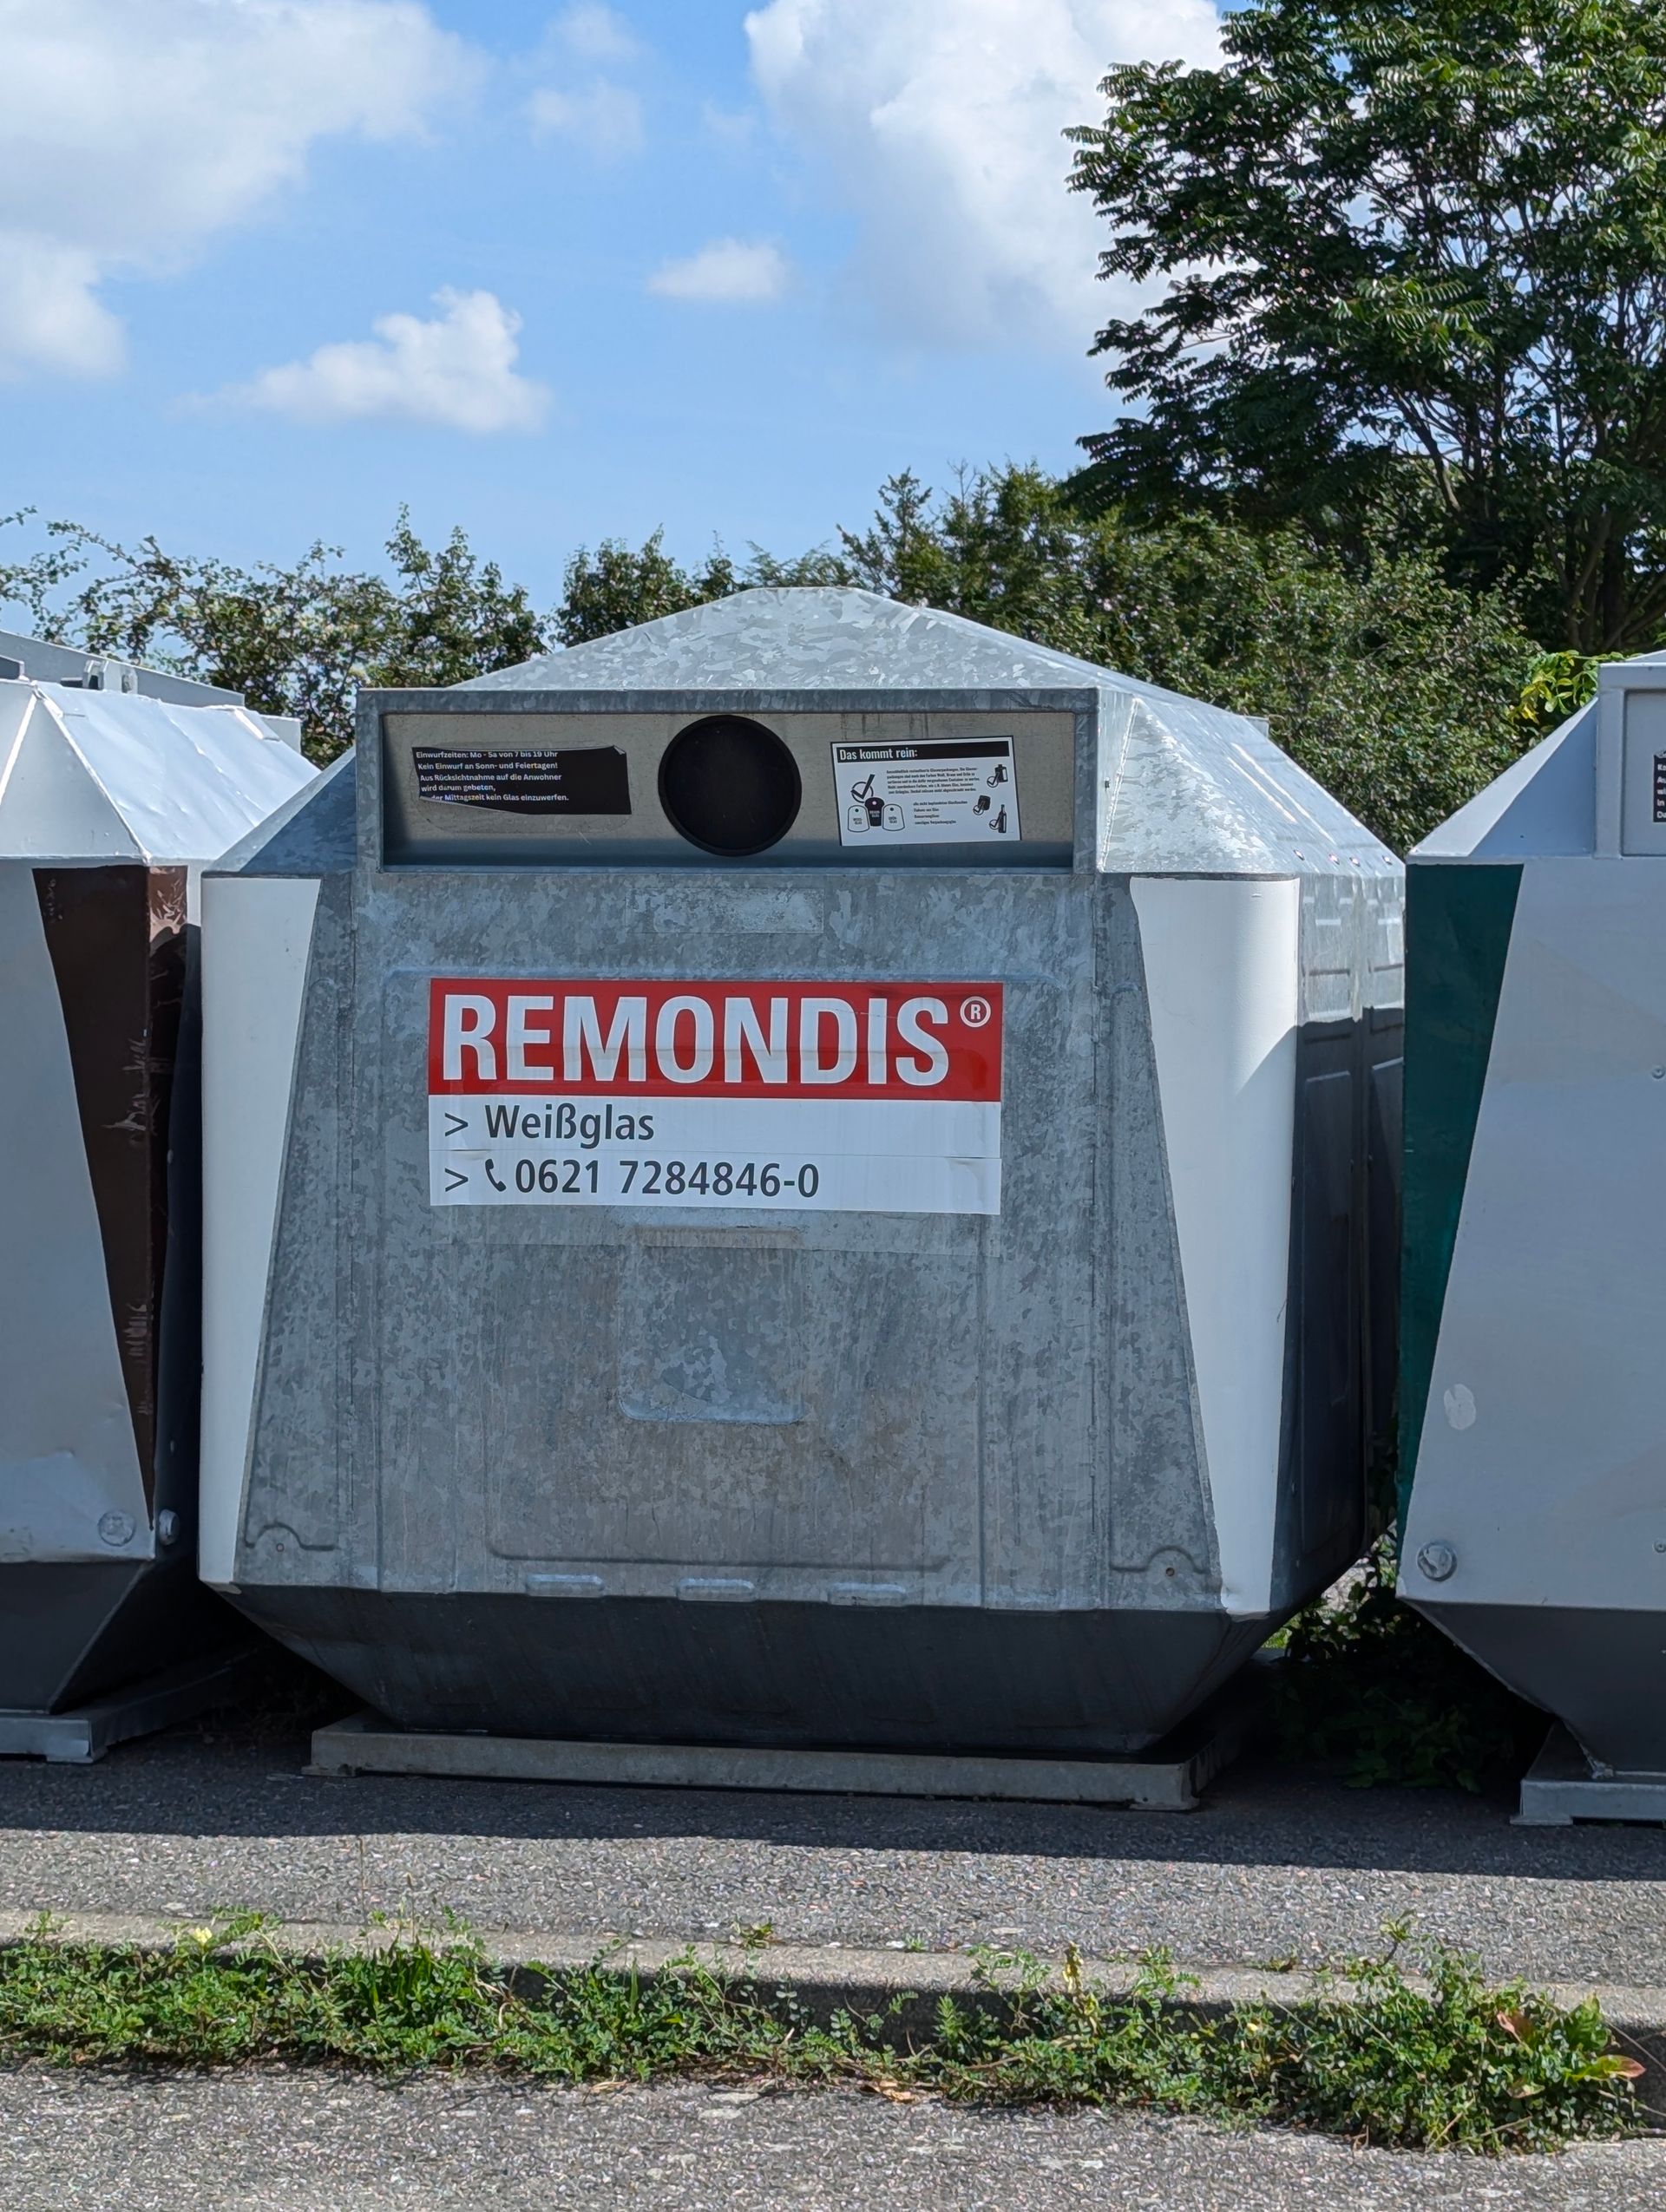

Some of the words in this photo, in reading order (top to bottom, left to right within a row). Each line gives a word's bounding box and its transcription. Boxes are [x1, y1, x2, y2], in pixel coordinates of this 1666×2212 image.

[515, 762, 558, 770] Feiertagen!
[839, 749, 857, 761] Das
[859, 749, 894, 760] kommt
[895, 748, 918, 758] rein:
[484, 1103, 655, 1150] Weißglas
[514, 1158, 600, 1195] 0621
[619, 1159, 820, 1199] 7284846-0
